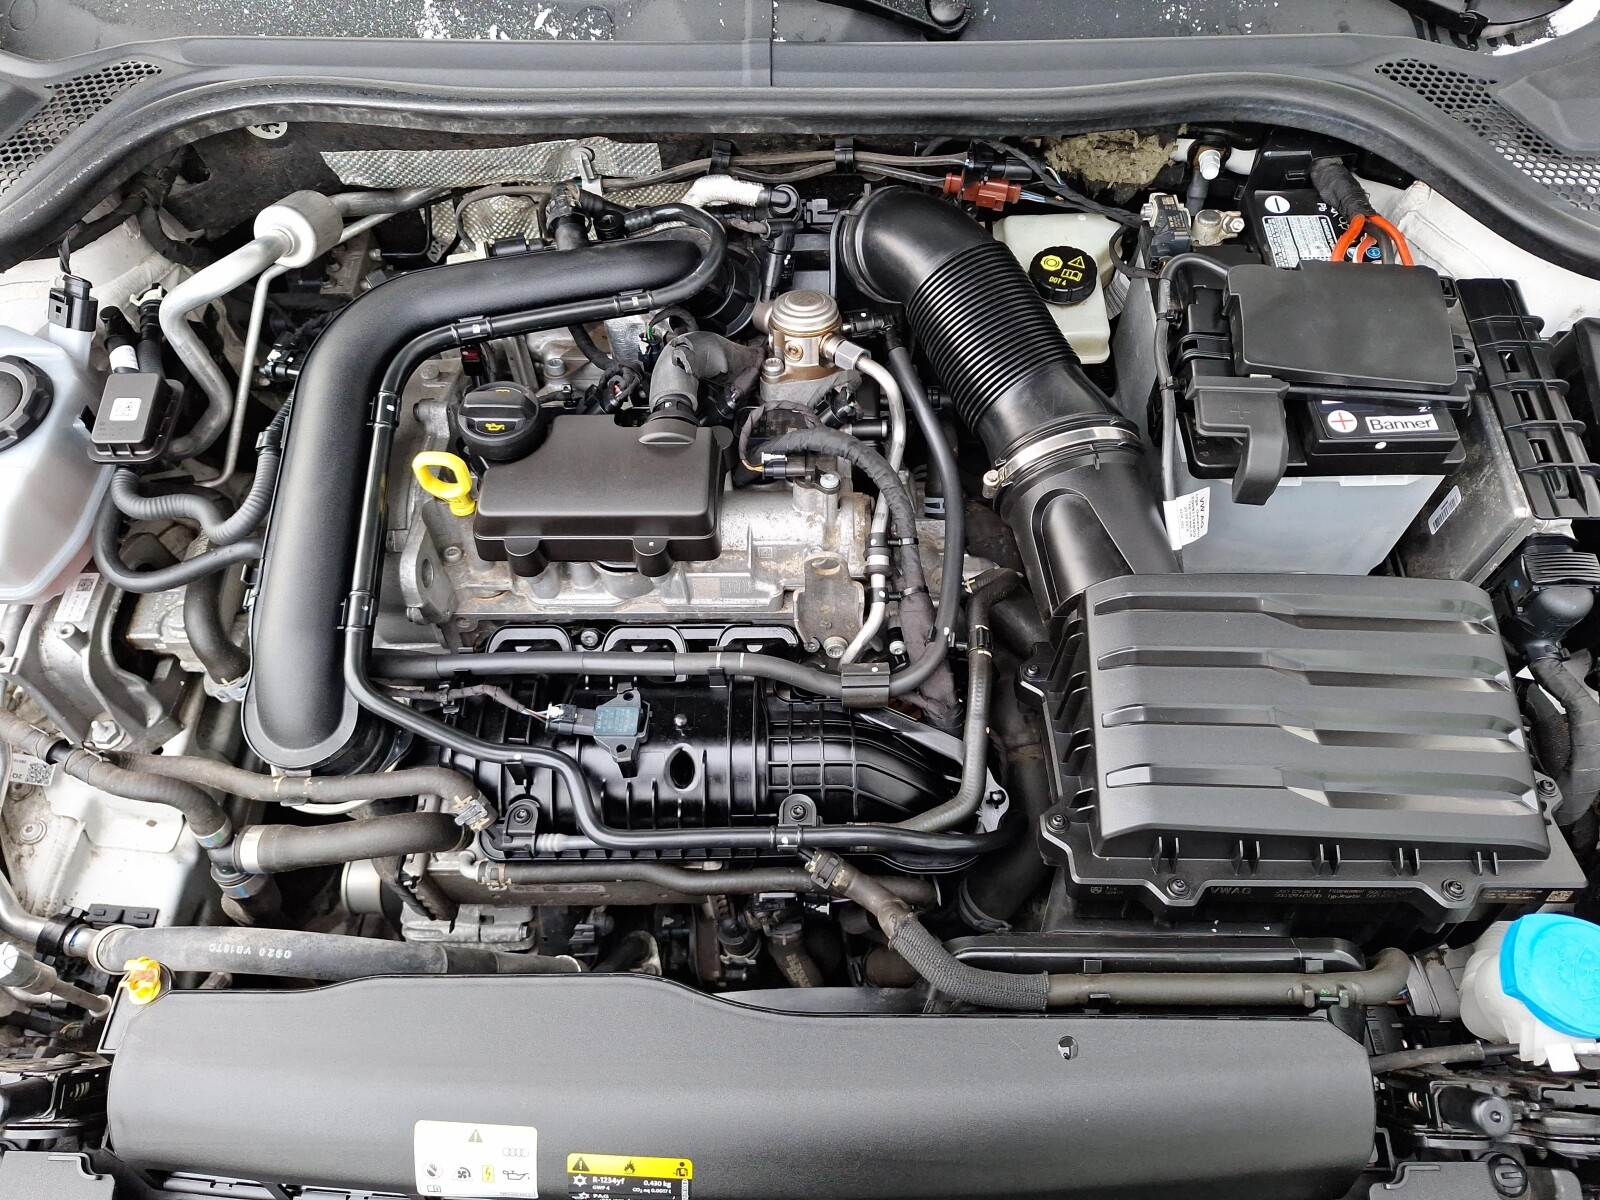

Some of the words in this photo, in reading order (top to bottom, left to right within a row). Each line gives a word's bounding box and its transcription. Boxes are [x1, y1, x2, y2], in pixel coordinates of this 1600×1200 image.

[1049, 276, 1062, 285] DOT
[1369, 418, 1432, 431] Banner
[592, 1176, 625, 1187] R-1234yf
[663, 1180, 672, 1189] kg
